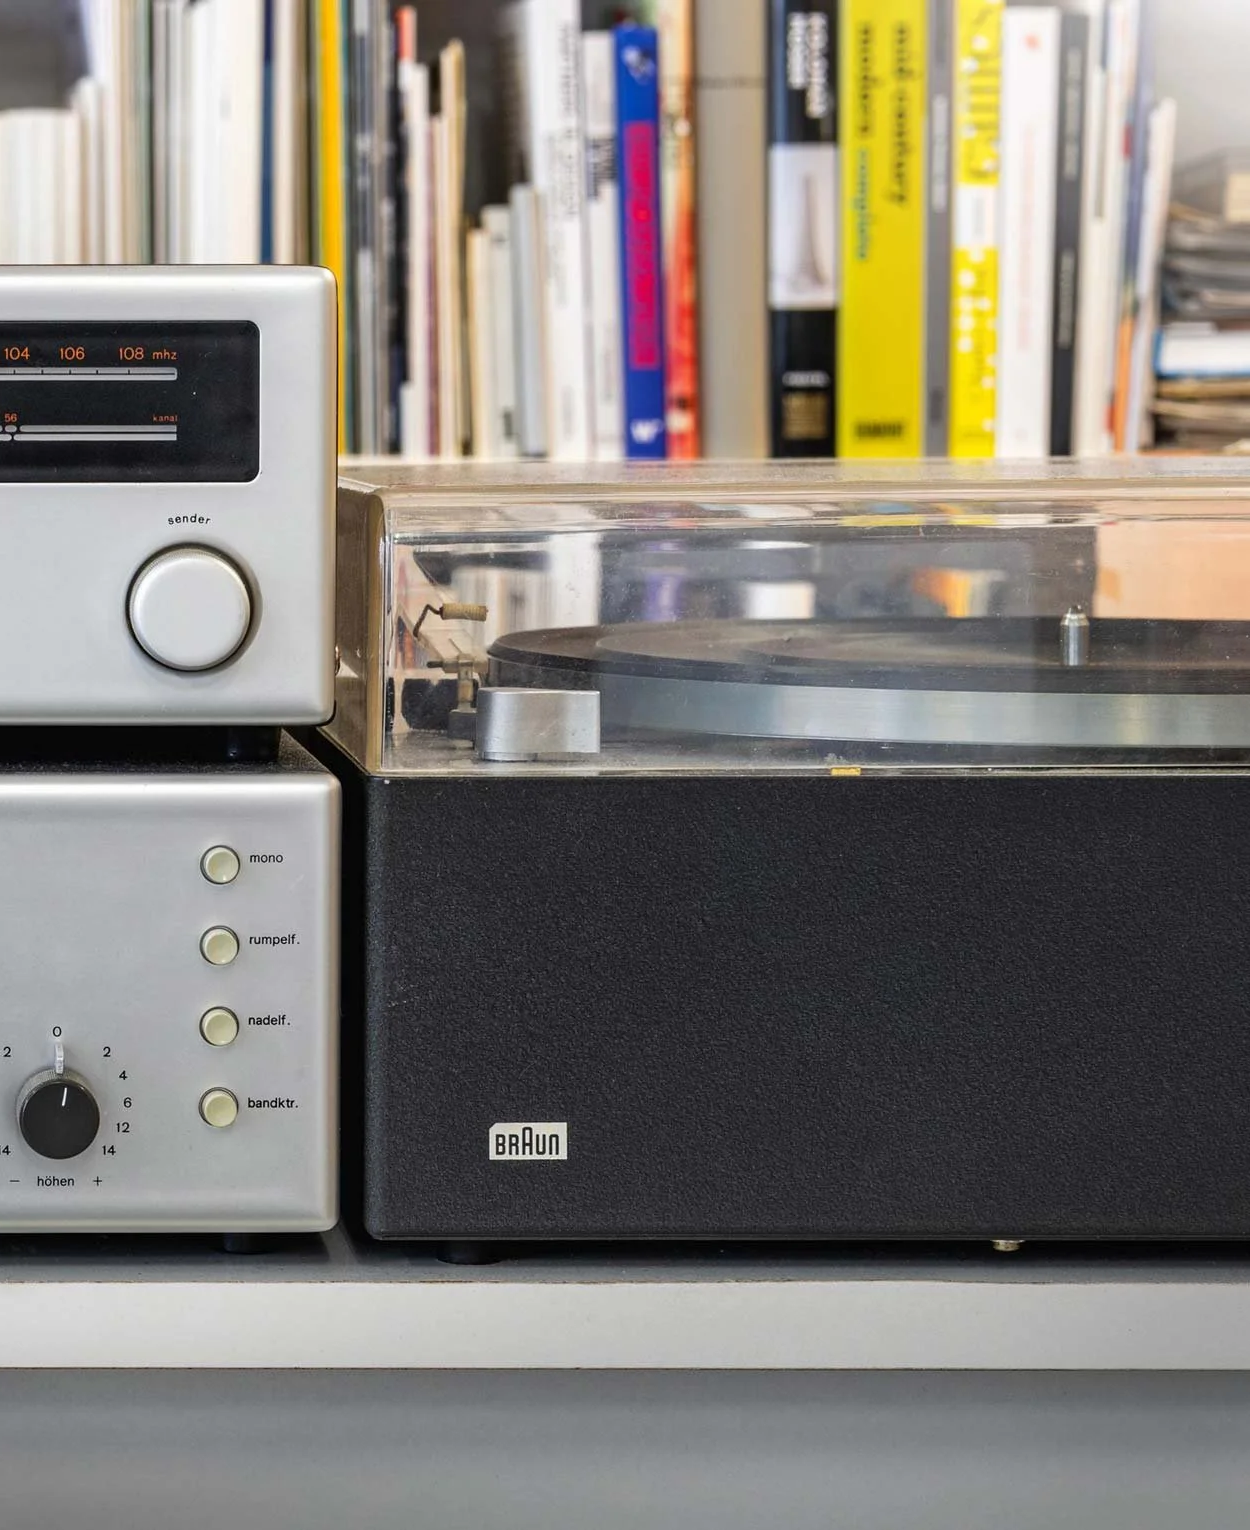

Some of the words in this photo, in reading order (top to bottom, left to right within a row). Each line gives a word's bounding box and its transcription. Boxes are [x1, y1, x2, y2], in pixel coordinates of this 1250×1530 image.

[3, 346, 31, 361] 104
[59, 346, 86, 361] 106
[119, 346, 145, 361] 108
[152, 348, 177, 360] mhz
[4, 413, 18, 423] 56
[152, 414, 178, 423] kanal
[167, 513, 211, 526] sender
[249, 854, 284, 864] mono
[248, 933, 300, 947] rumpelf.
[248, 1014, 291, 1026] nadelf.
[52, 1025, 63, 1038] 0
[3, 1046, 12, 1058] 2
[102, 1046, 111, 1058] 2
[118, 1070, 128, 1081] 4
[123, 1096, 133, 1109] 6
[247, 1097, 299, 1109] bandktr.
[116, 1121, 130, 1134] 12
[496, 1127, 559, 1155] BRAUN
[102, 1144, 117, 1156] 14
[37, 1175, 75, 1187] höhen
